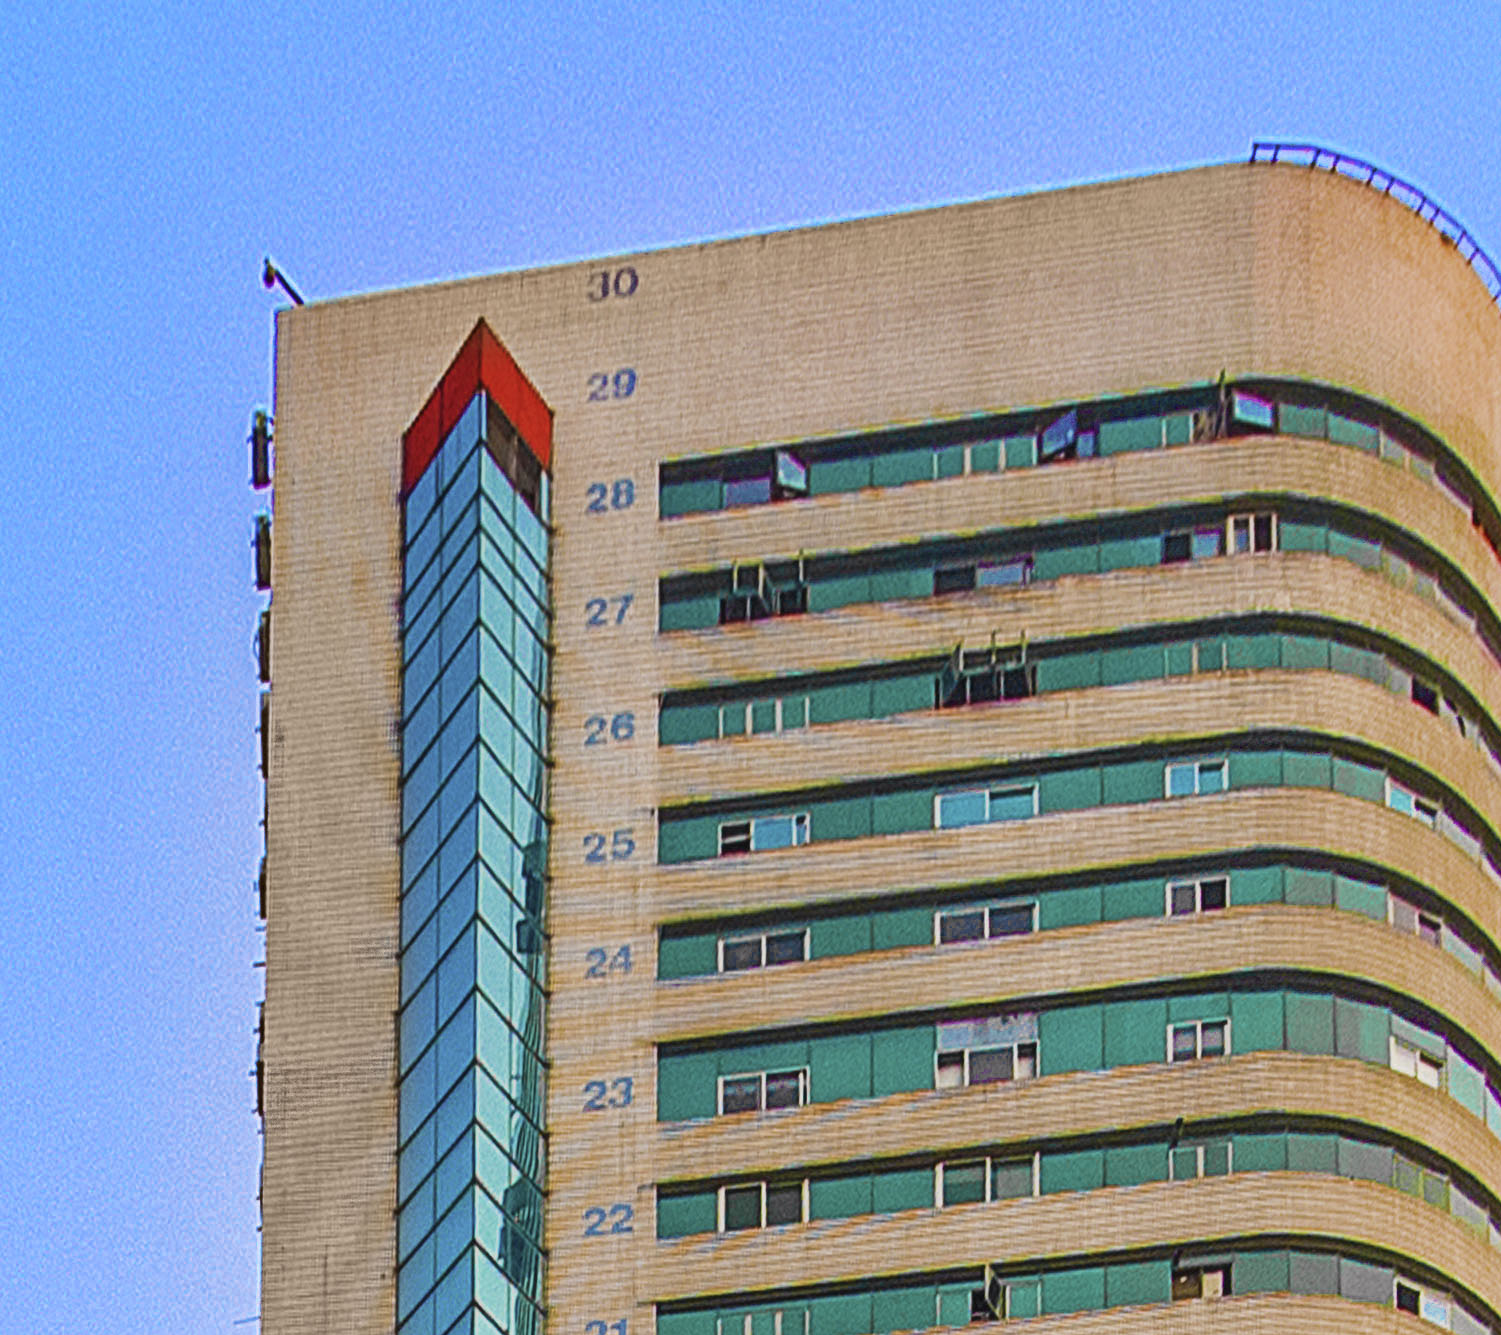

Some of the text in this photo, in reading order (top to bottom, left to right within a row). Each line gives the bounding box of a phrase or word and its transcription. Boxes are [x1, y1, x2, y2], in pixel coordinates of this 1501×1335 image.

[588, 268, 638, 301] 30
[587, 369, 637, 402] 29
[586, 481, 635, 512] 28
[585, 597, 633, 627] 27
[584, 713, 636, 746] 26
[584, 831, 635, 862] 25
[584, 946, 634, 978] 24
[584, 1078, 634, 1110] 23
[582, 1206, 634, 1236] 22
